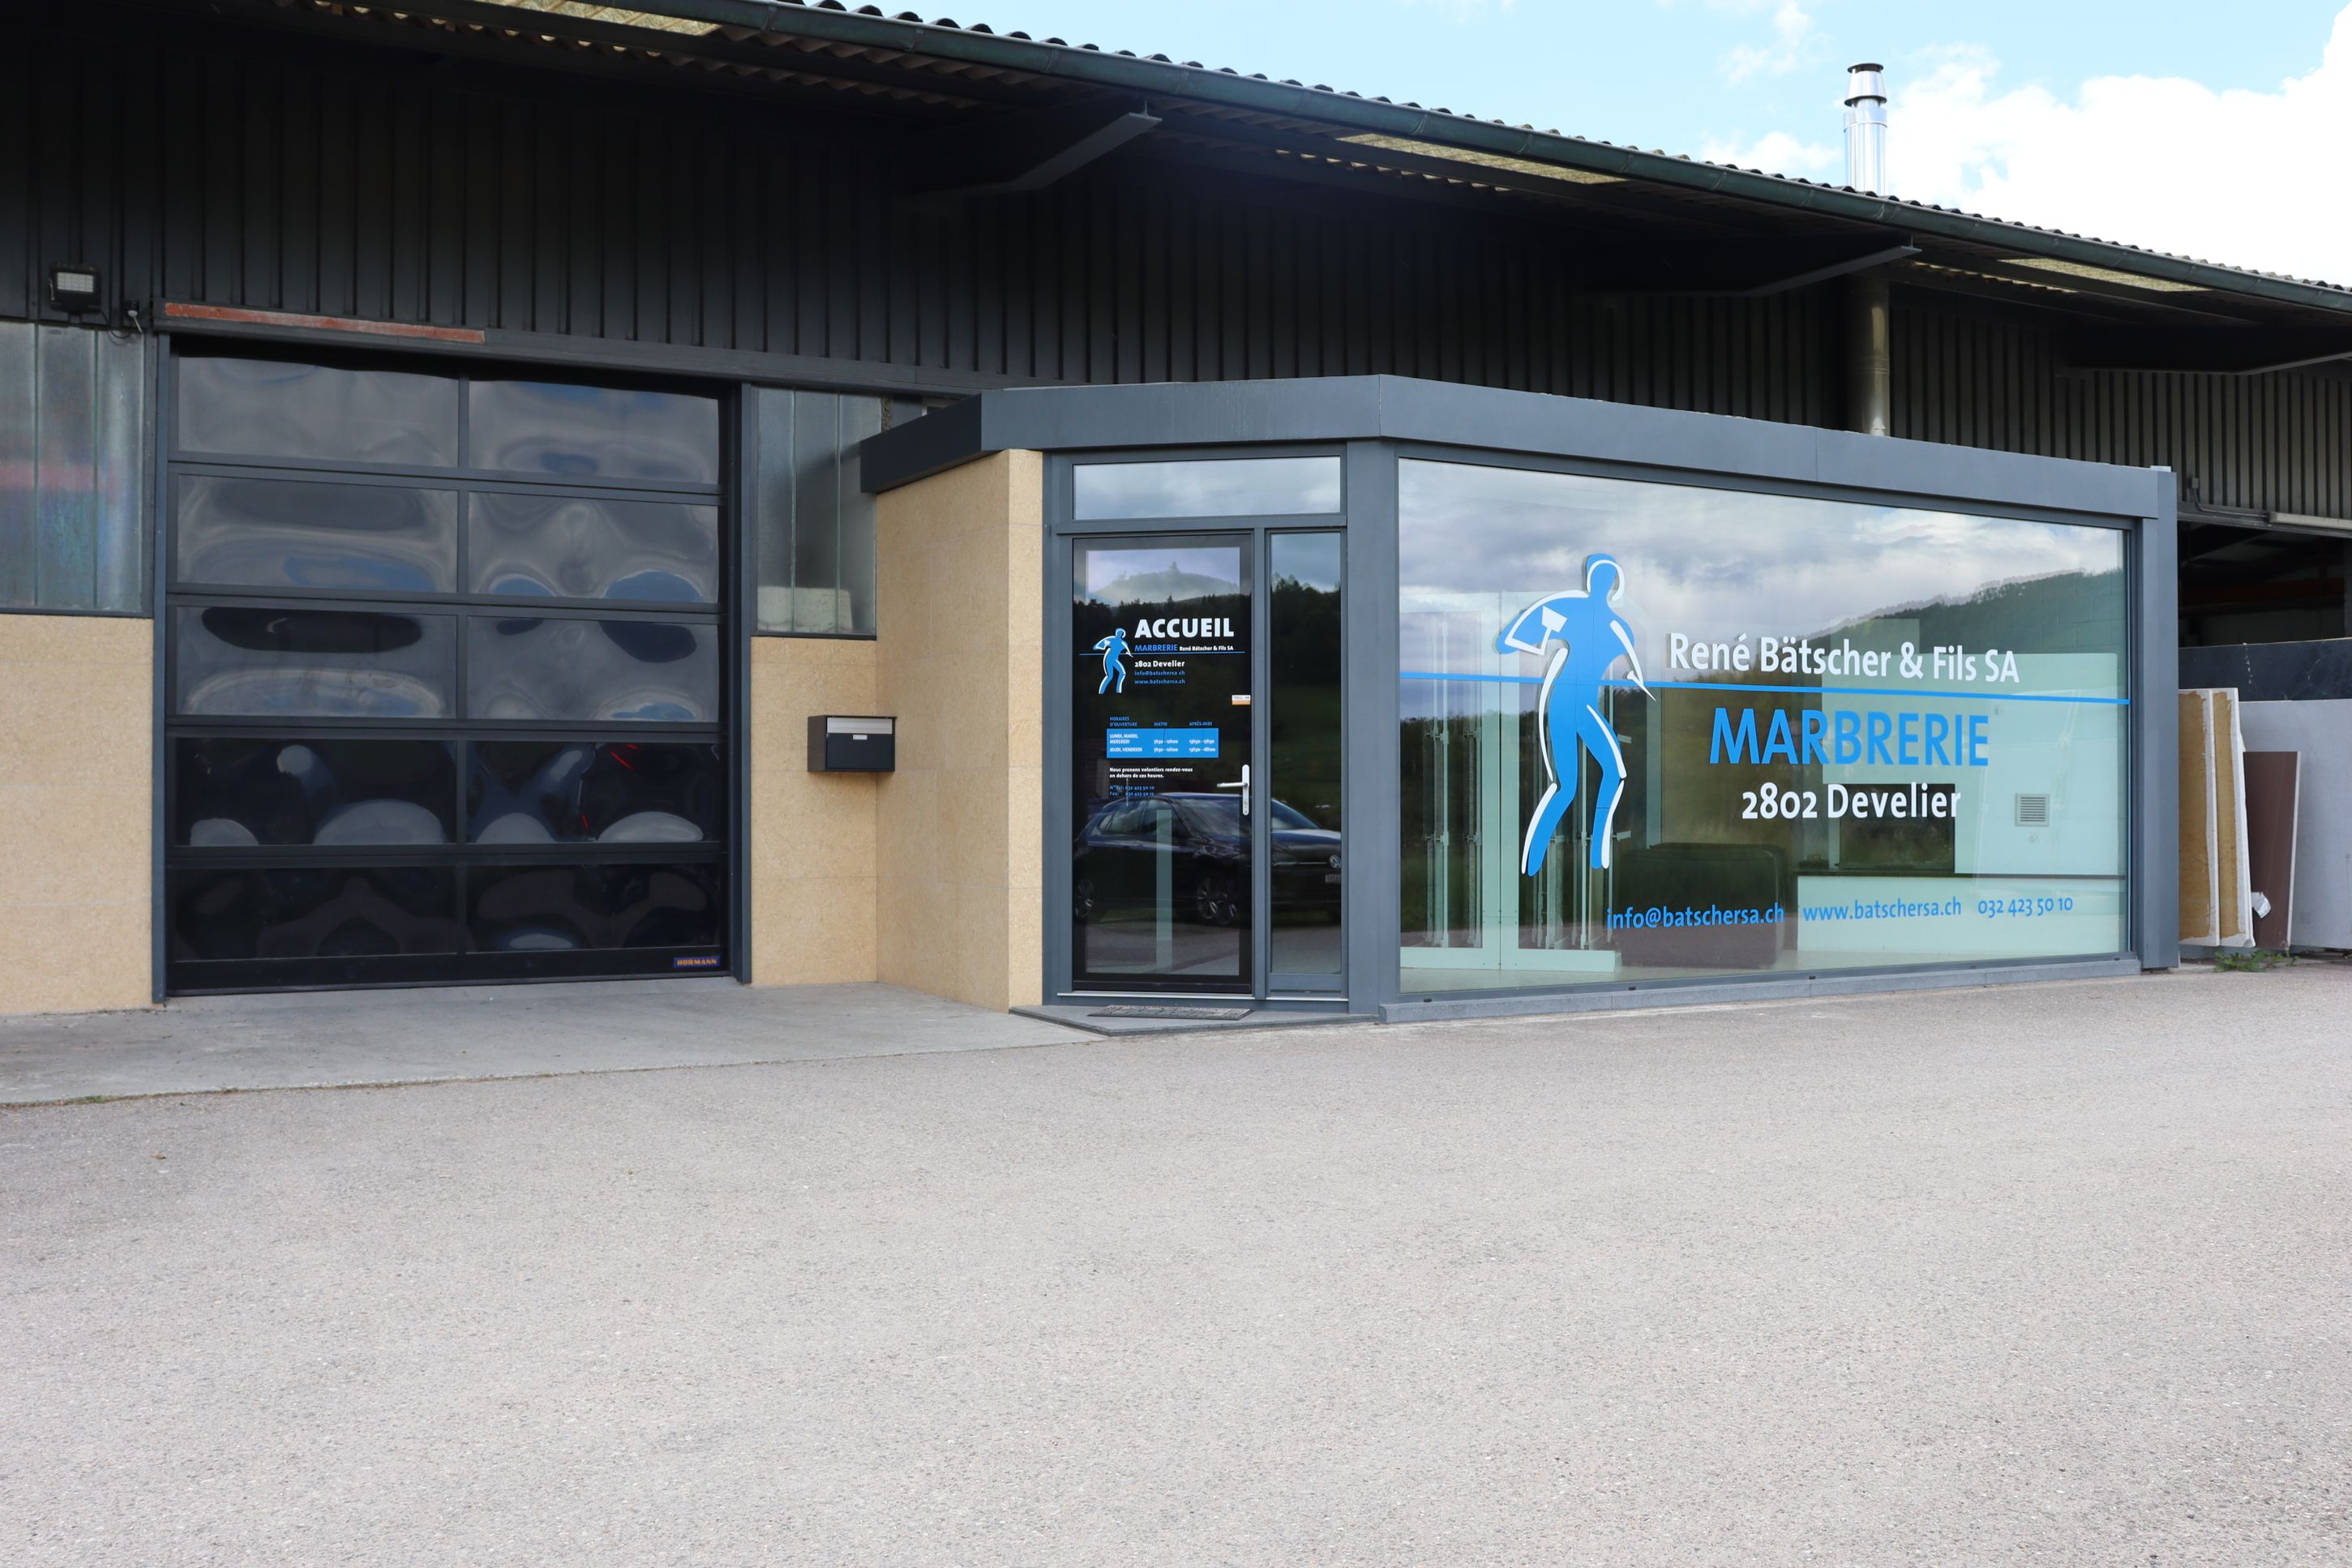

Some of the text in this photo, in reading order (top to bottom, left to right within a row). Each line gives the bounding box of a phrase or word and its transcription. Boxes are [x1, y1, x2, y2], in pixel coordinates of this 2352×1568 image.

[1134, 618, 1235, 638] ACCUEIL
[1670, 632, 2020, 683] René Bätscher & Fils SA
[1710, 707, 1989, 766] MARBRERIE
[1742, 782, 1961, 819] 2802 Develier
[1607, 902, 1784, 929] info@batschersa.ch
[1803, 897, 1961, 921] www.batschersa.ch
[1978, 898, 2073, 919] 032 423 50 10
